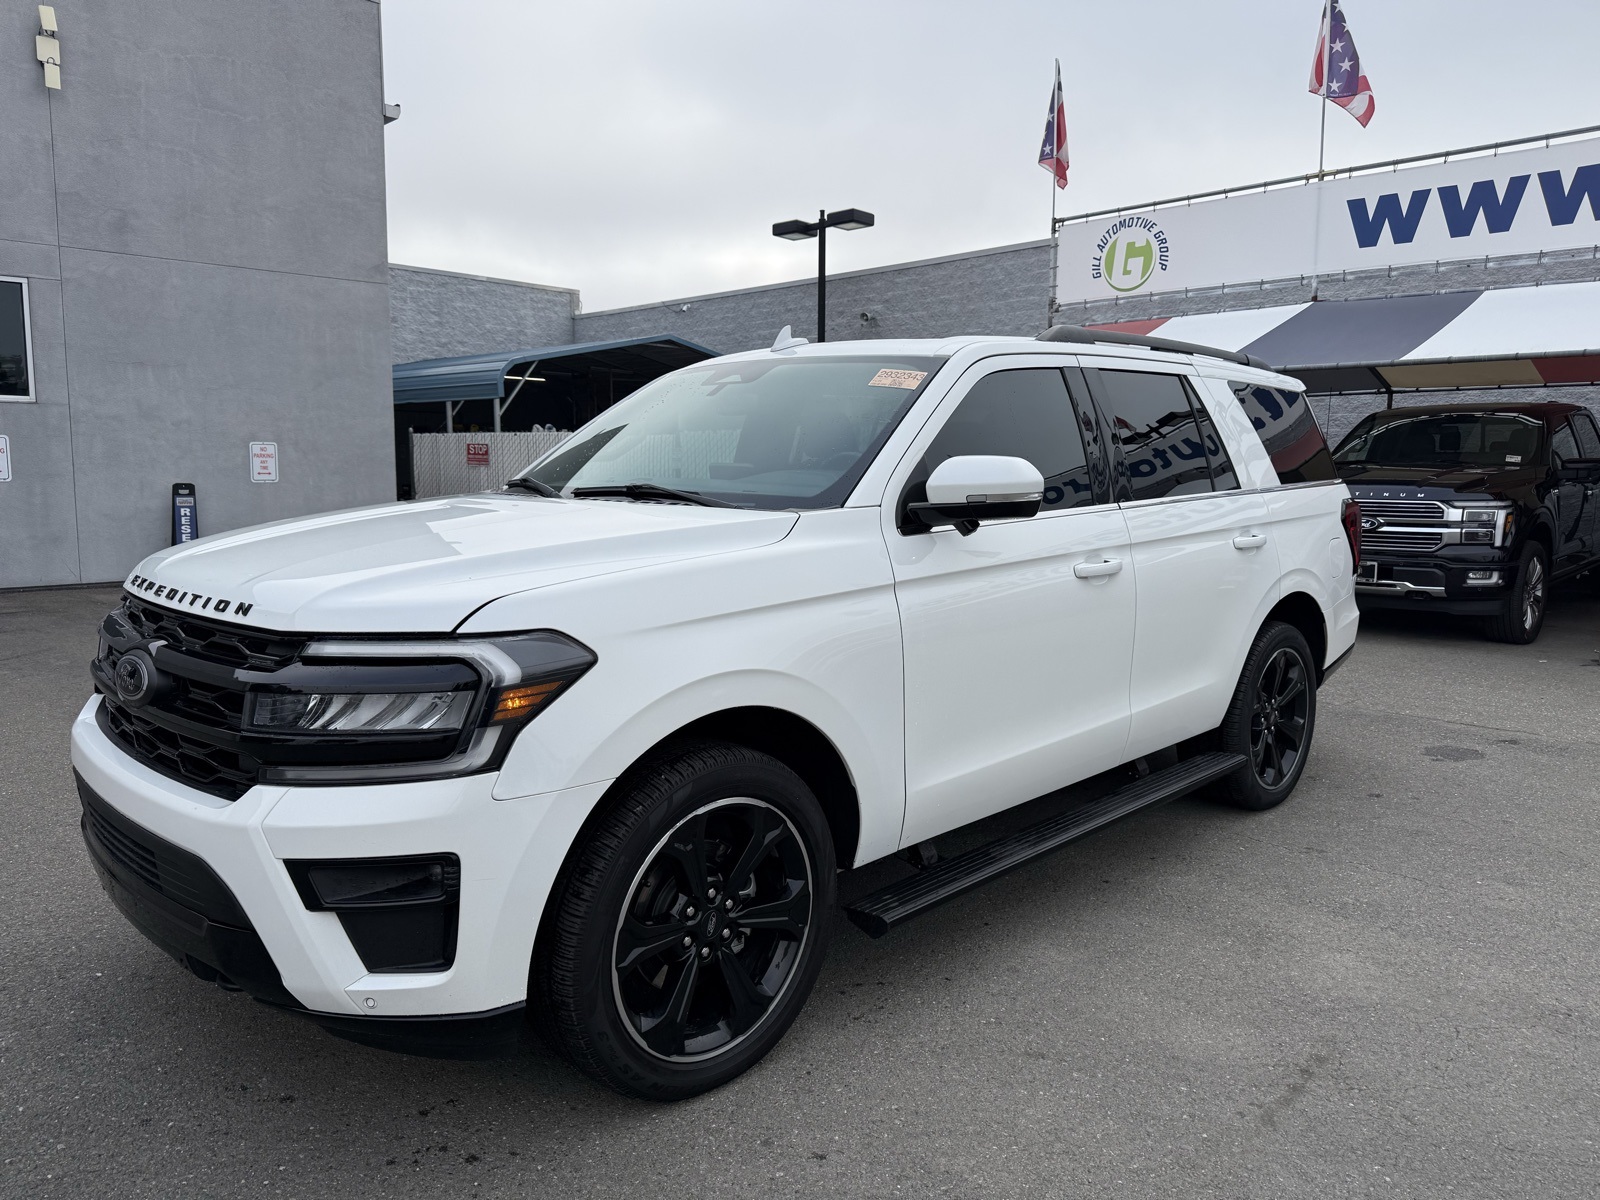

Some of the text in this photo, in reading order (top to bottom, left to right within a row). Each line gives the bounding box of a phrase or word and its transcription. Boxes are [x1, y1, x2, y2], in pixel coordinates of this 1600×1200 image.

[1091, 216, 1170, 279] GILL AUTOMOTIVE GROUP
[469, 444, 488, 454] STOP
[130, 574, 254, 617] EXPEDITION
